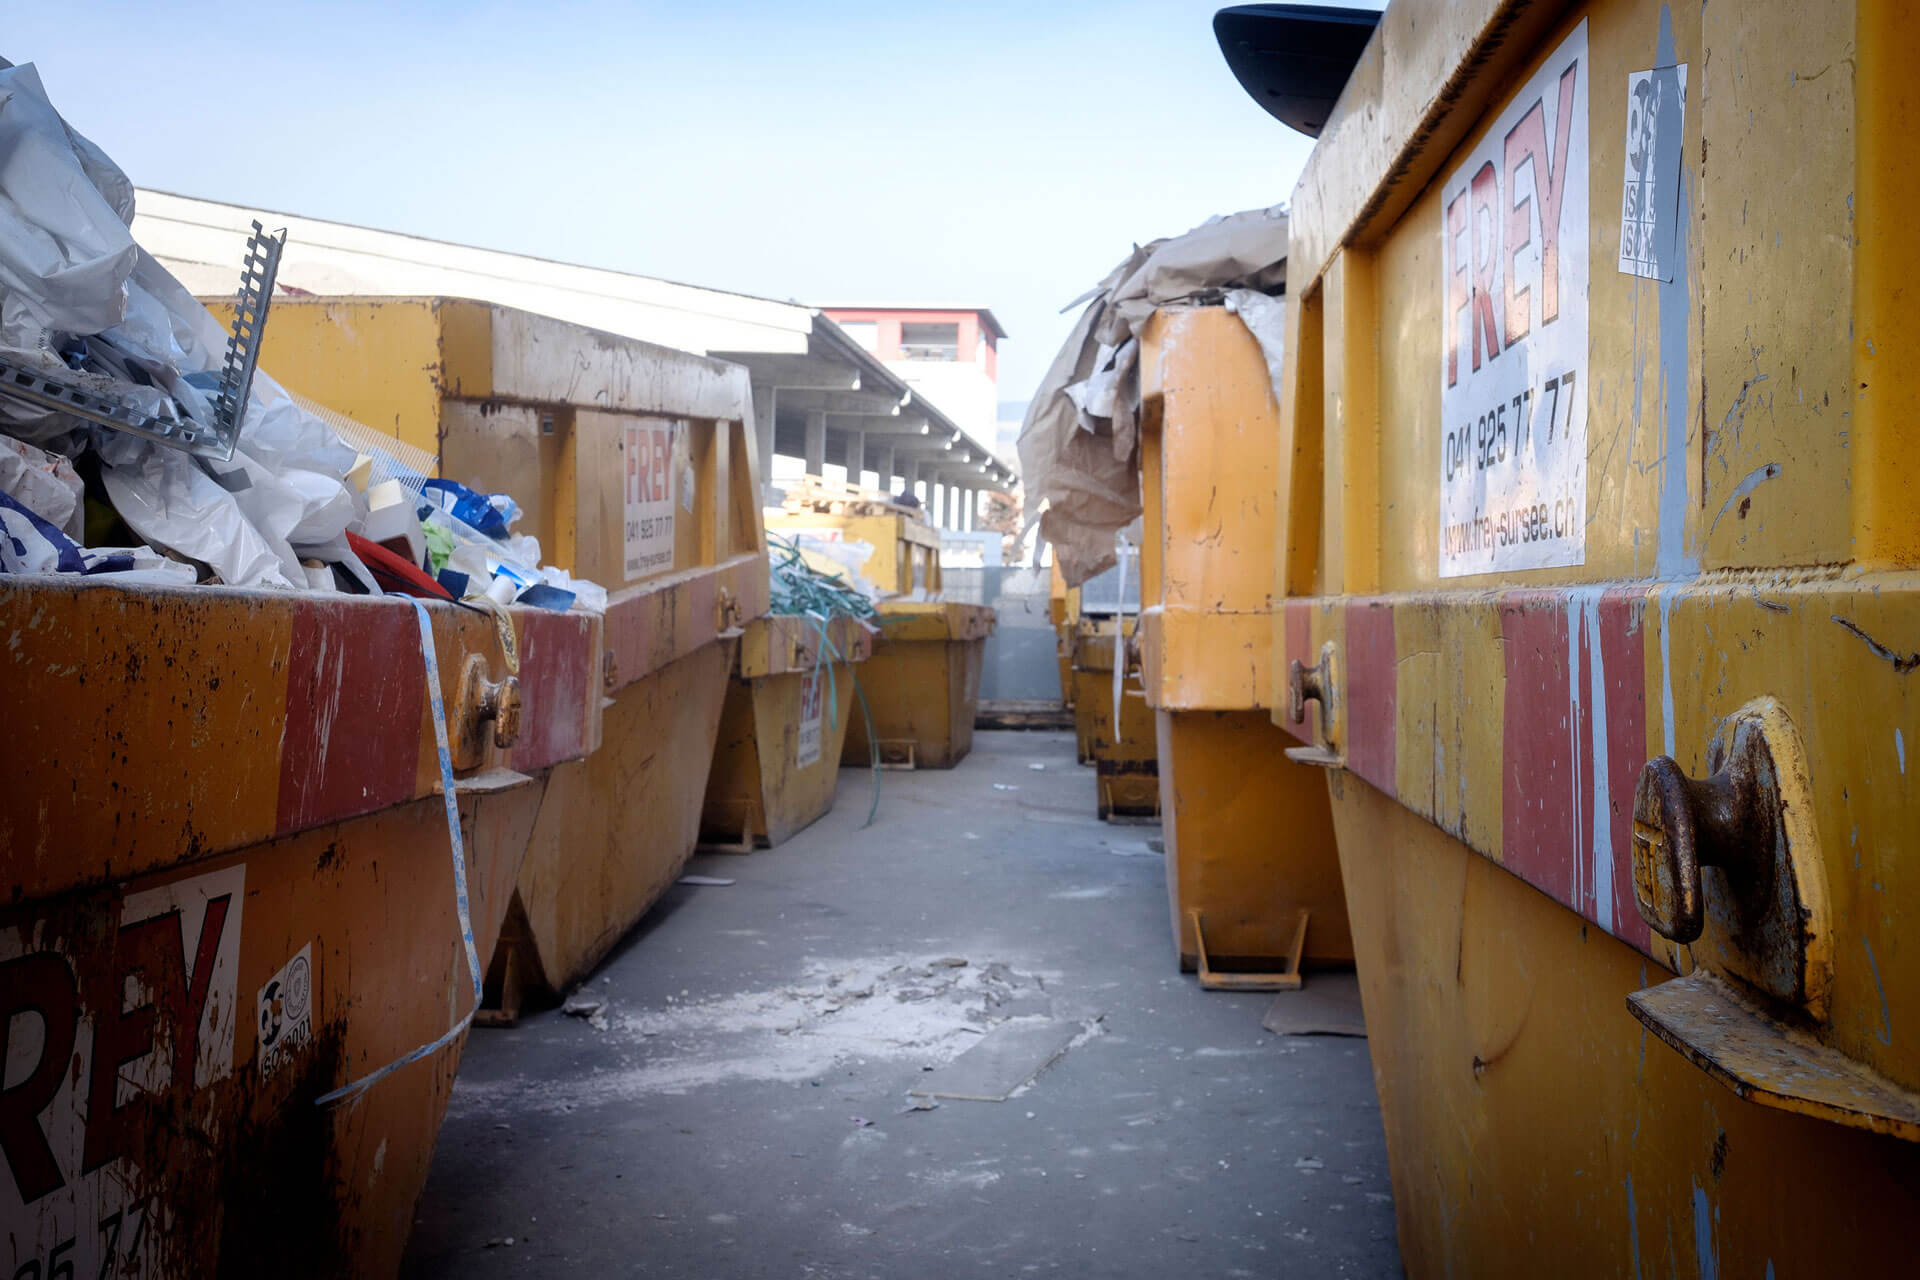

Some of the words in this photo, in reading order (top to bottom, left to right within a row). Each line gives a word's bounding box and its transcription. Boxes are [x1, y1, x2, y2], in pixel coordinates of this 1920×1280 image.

[1447, 57, 1578, 390] FREY
[626, 428, 674, 505] FREY
[1446, 422, 1471, 483] 041
[1477, 402, 1506, 470] 925
[1512, 387, 1534, 457] 77
[1545, 369, 1576, 446] 77
